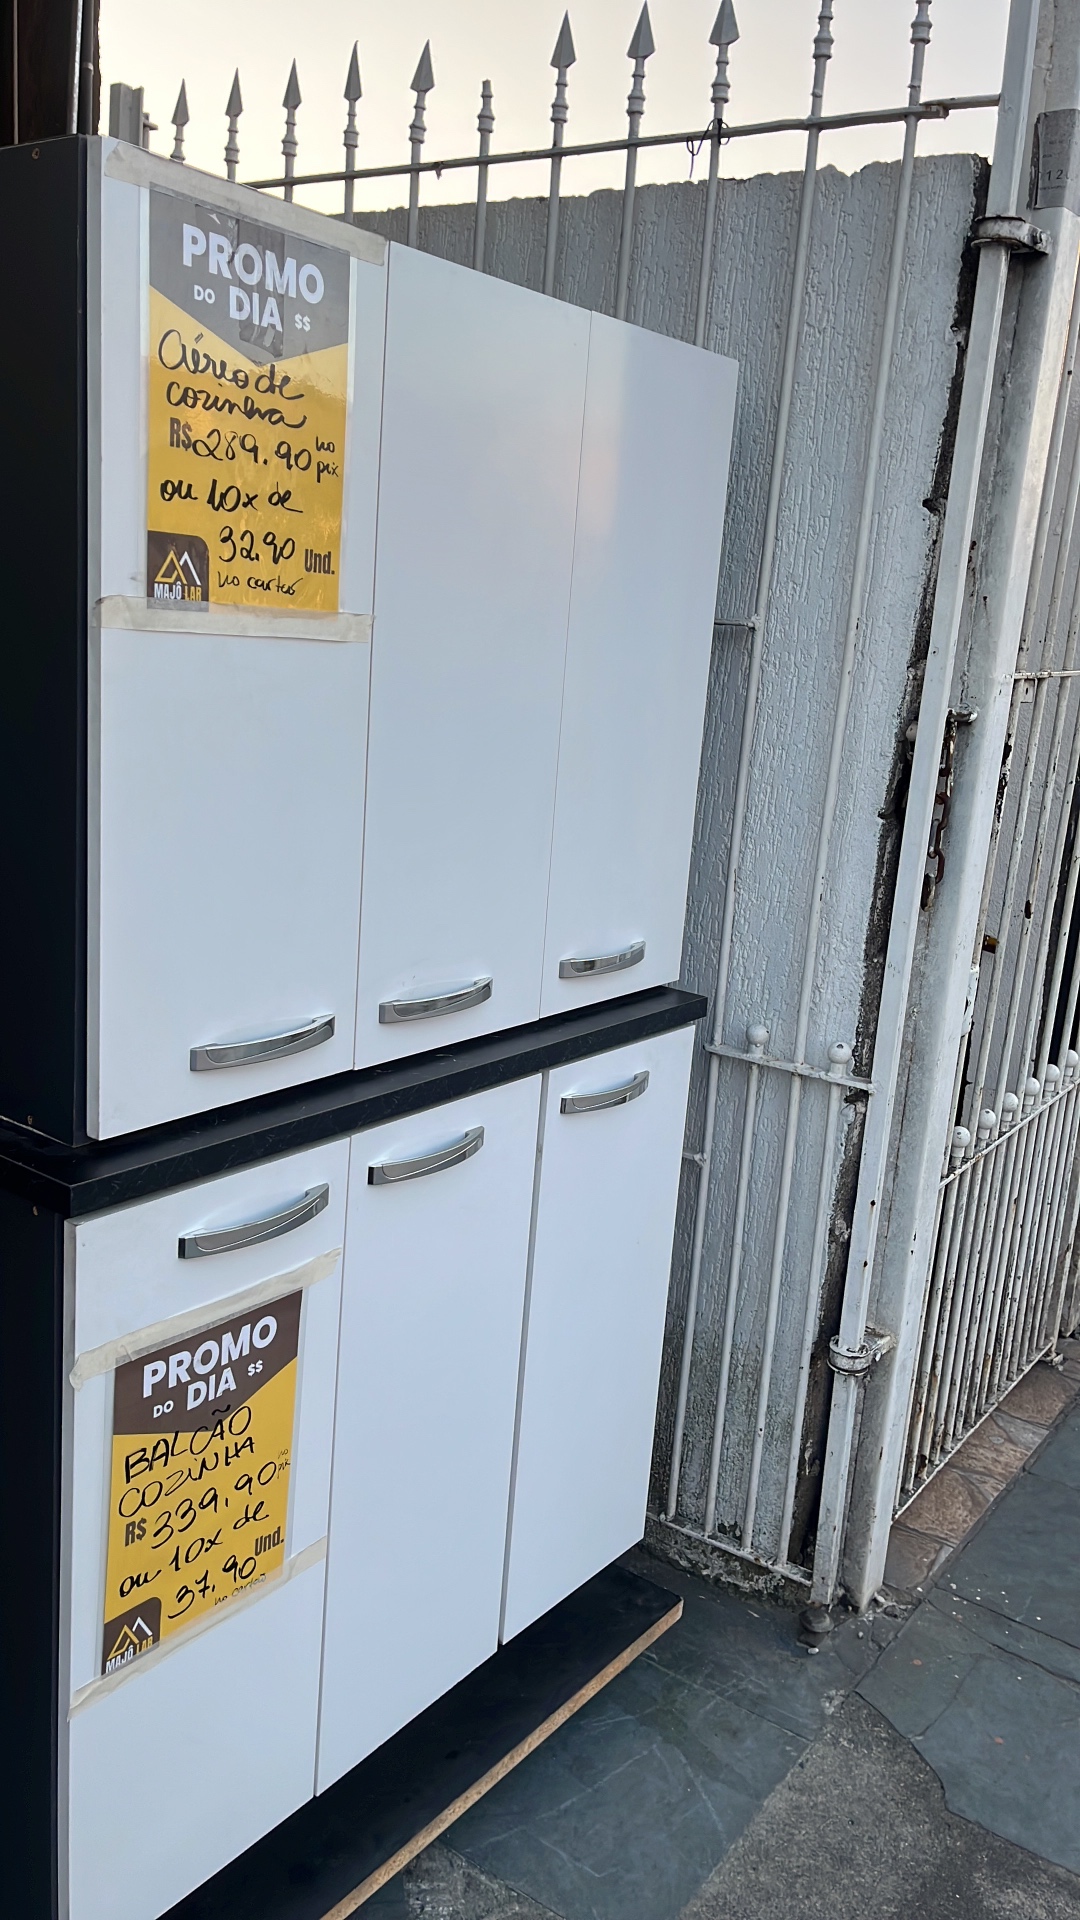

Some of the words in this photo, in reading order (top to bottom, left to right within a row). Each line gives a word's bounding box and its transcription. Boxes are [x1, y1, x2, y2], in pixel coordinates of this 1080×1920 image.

[182, 222, 325, 305] PROMO
[193, 284, 216, 305] DO
[229, 285, 283, 333] DIA
[254, 363, 305, 400] de
[169, 417, 193, 452] R$
[160, 478, 199, 502] ou
[206, 478, 259, 513] 10x
[268, 481, 304, 514] de
[304, 548, 336, 576] Und.
[153, 580, 183, 601] MAJÔ
[184, 585, 203, 602] LAR
[142, 1315, 278, 1399] PROMO
[152, 1400, 174, 1419] DO
[186, 1366, 237, 1411] DIA
[124, 1403, 252, 1485] BALCÃO
[118, 1569, 163, 1598] ou
[168, 1528, 223, 1572] 10x
[232, 1500, 270, 1530] de
[124, 1517, 148, 1548] R$
[254, 1525, 285, 1557] Und.
[105, 1644, 134, 1675] MAJÔ
[136, 1635, 153, 1656] LAR
